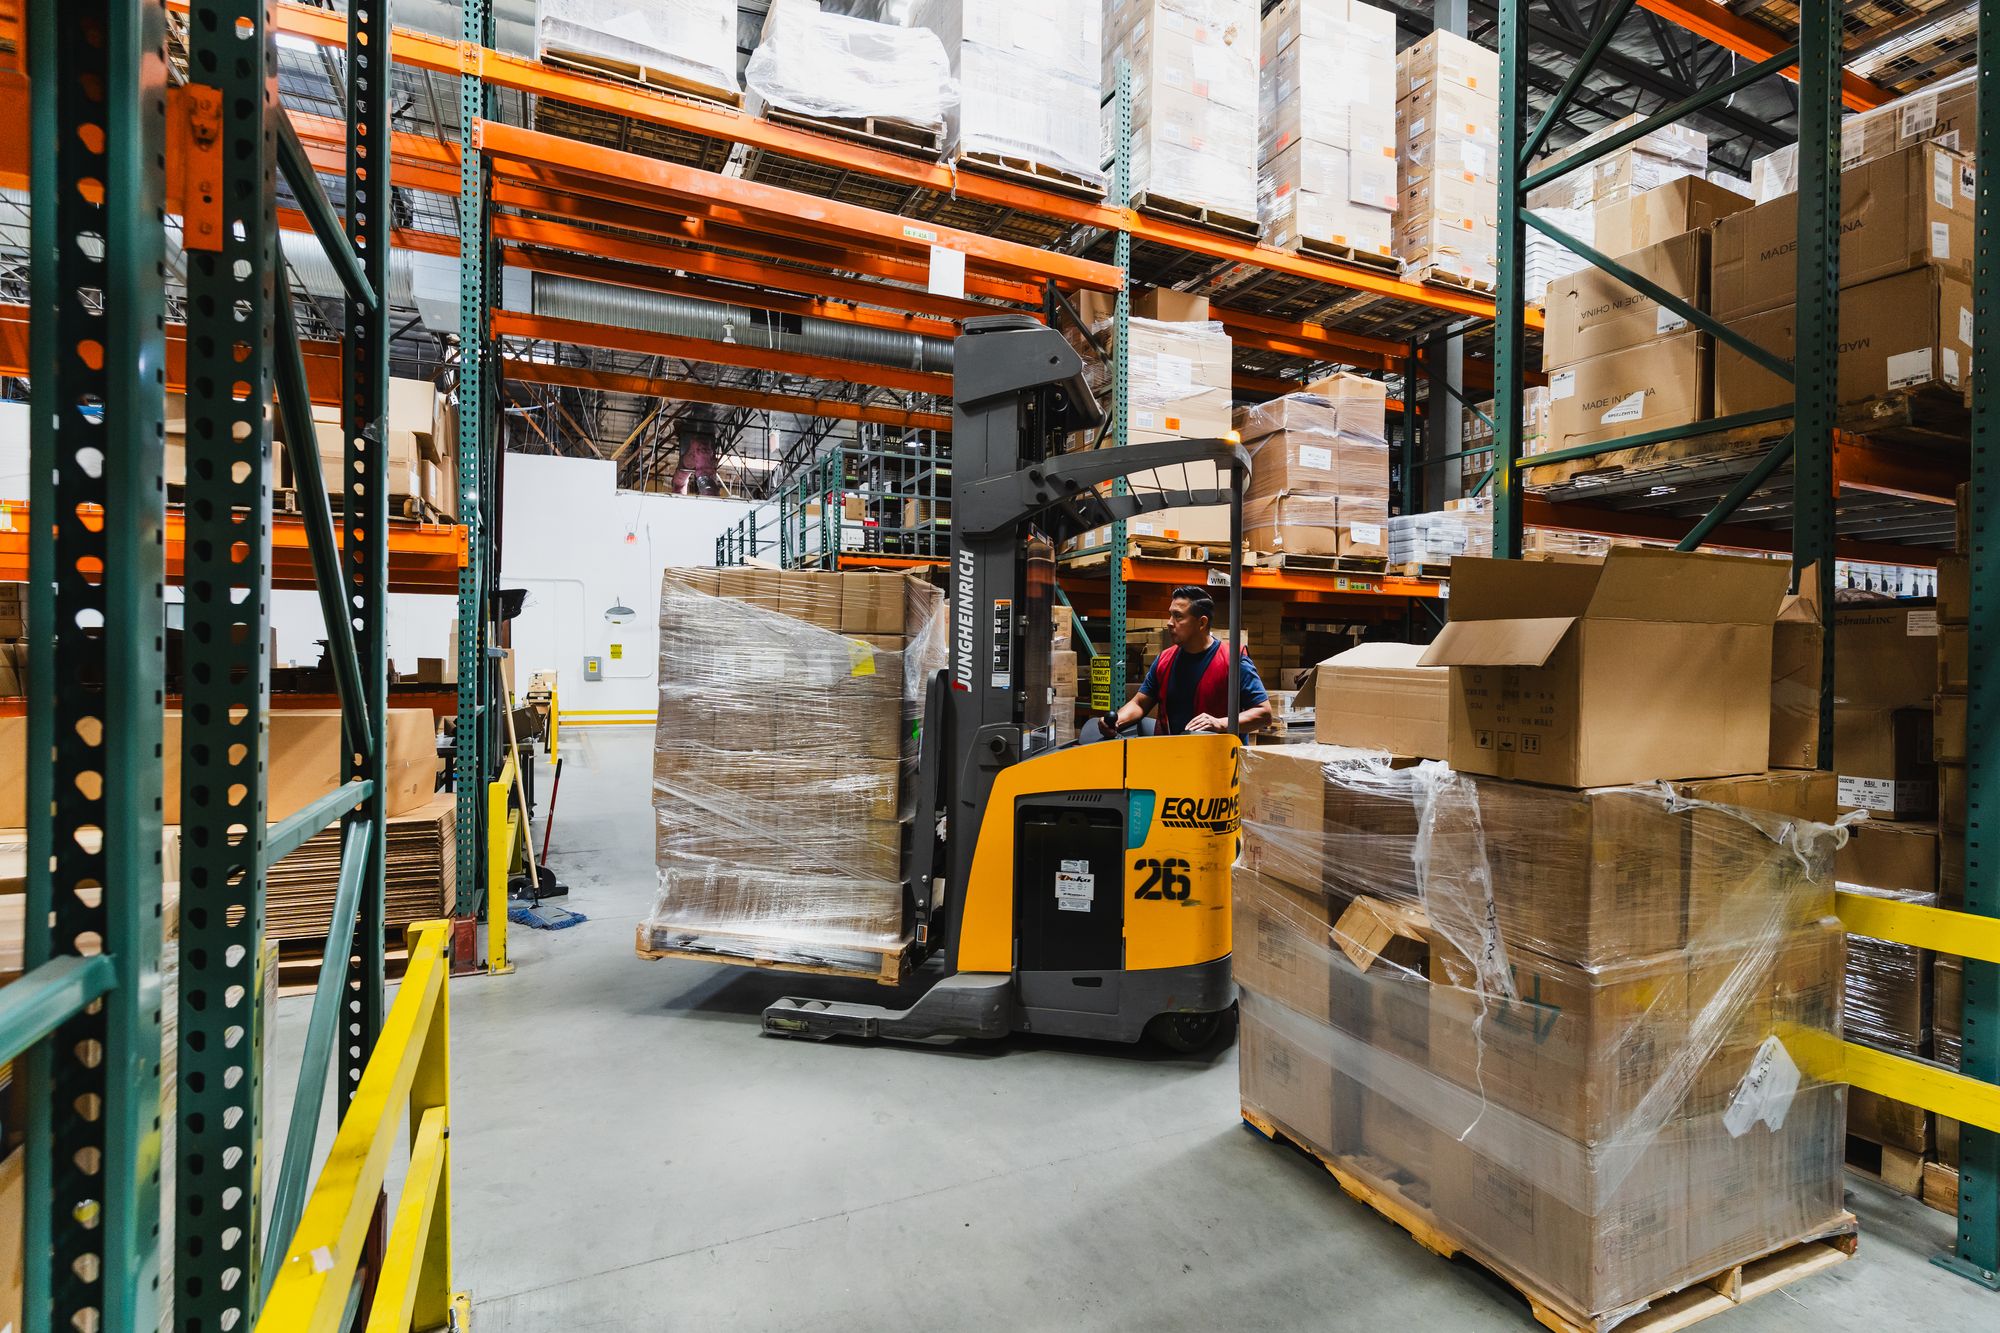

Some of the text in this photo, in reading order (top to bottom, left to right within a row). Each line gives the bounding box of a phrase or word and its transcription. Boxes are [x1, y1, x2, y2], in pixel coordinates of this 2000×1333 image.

[1580, 294, 1650, 320] ADE IN CHINA
[1839, 338, 1870, 354] MAD
[1582, 397, 1611, 412] MADE
[1612, 395, 1623, 405] IN
[953, 550, 974, 693] JUNGHEINRICH
[1093, 660, 1109, 668] CAUTION
[1093, 669, 1110, 677] FORKLIFT
[1133, 857, 1191, 901] 26
